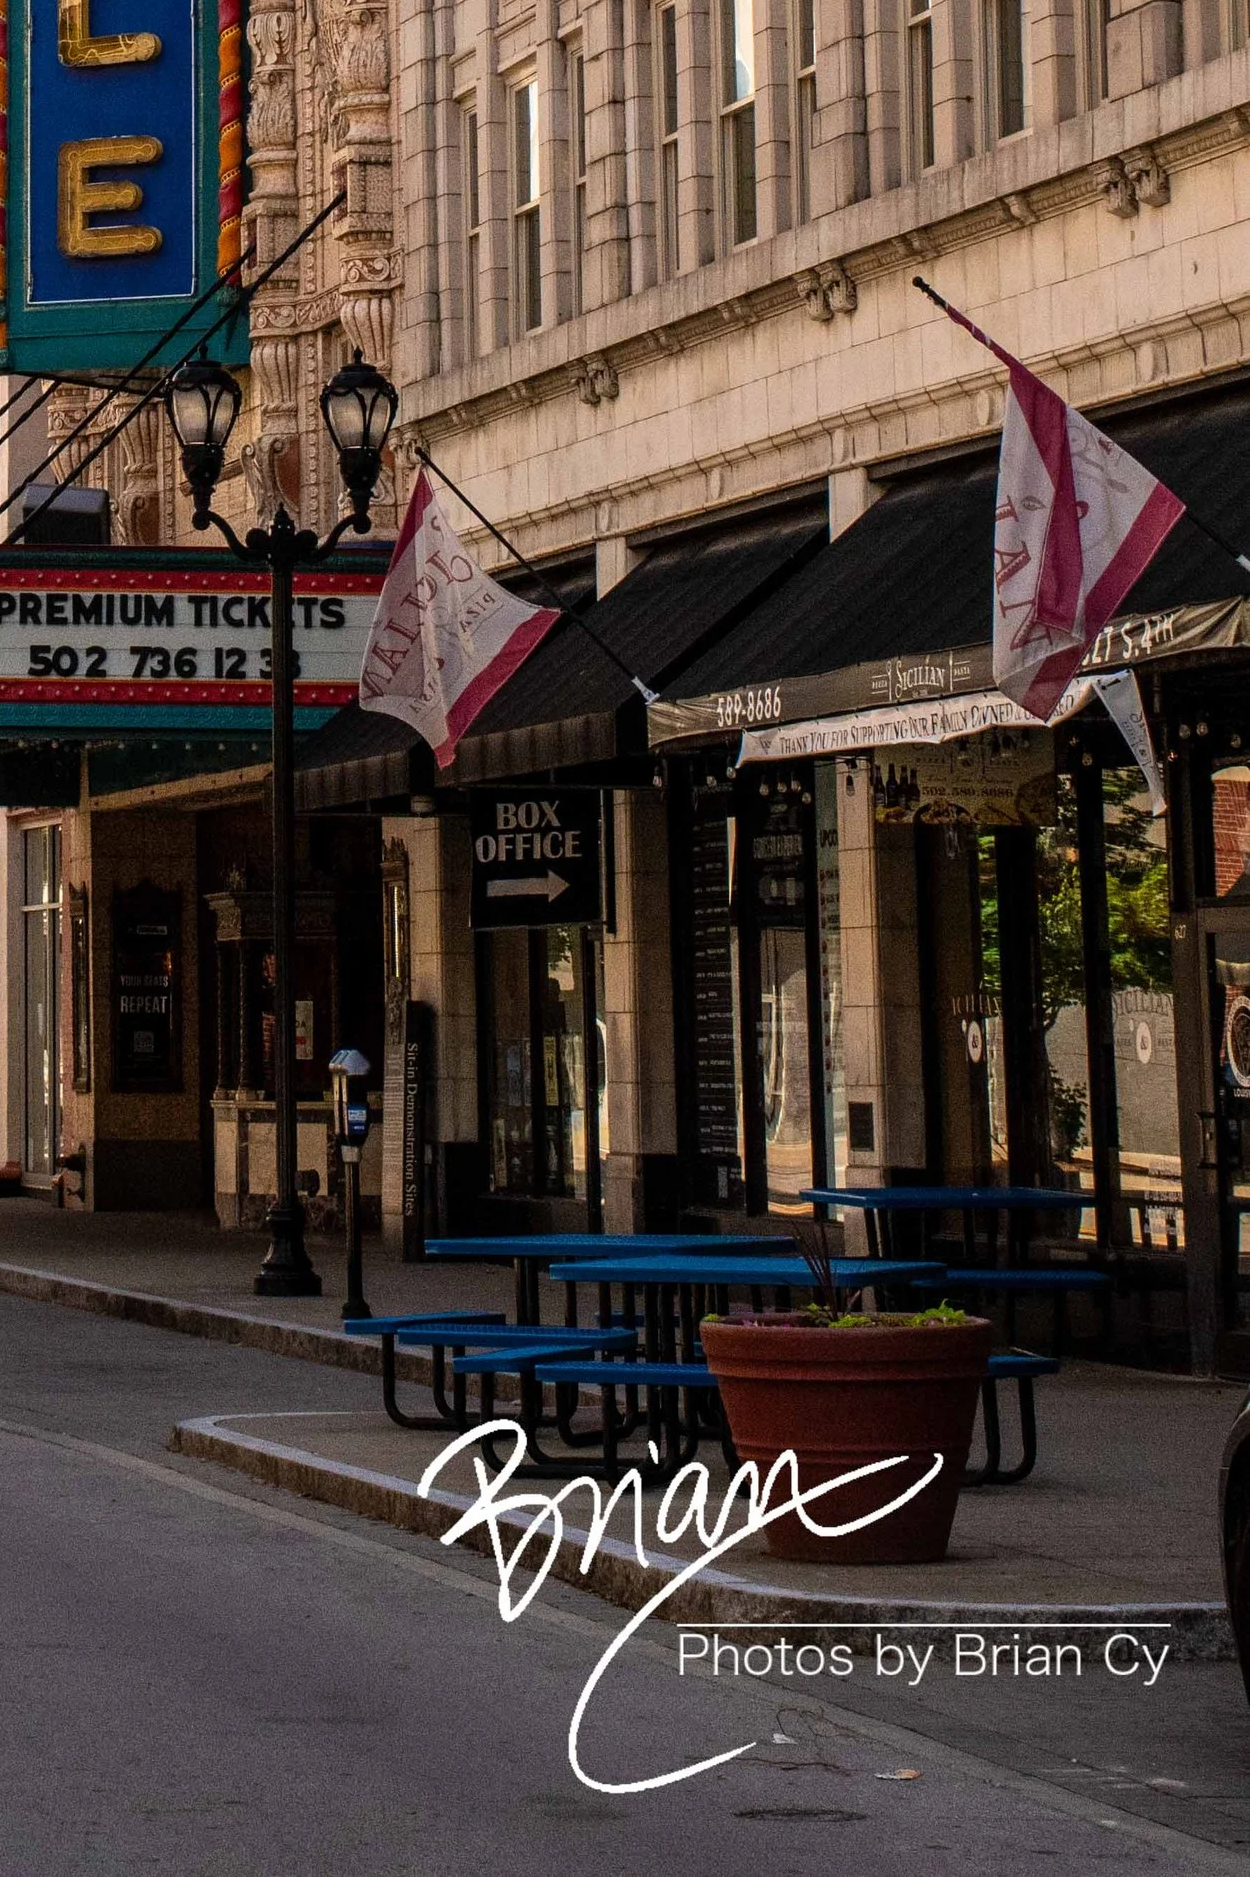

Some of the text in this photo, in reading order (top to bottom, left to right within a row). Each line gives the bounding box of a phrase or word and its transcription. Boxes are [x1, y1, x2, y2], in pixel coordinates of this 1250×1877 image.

[188, 595, 346, 629] TICKTS
[27, 644, 107, 678] 502
[130, 645, 197, 679] 736
[895, 660, 945, 698] SICILIAN
[716, 685, 782, 727] 589-8686
[779, 735, 809, 754] THANK
[810, 731, 831, 752] YOU
[831, 729, 849, 749] FOR
[850, 720, 908, 745] SUPPORTING
[909, 716, 930, 739] OUR
[970, 703, 1014, 728] OWNED
[496, 799, 561, 830] BOX
[475, 830, 584, 864] OFFICE
[120, 995, 168, 1014] REPEAT
[404, 1041, 419, 1217] Sit-in Demonstration Sites
